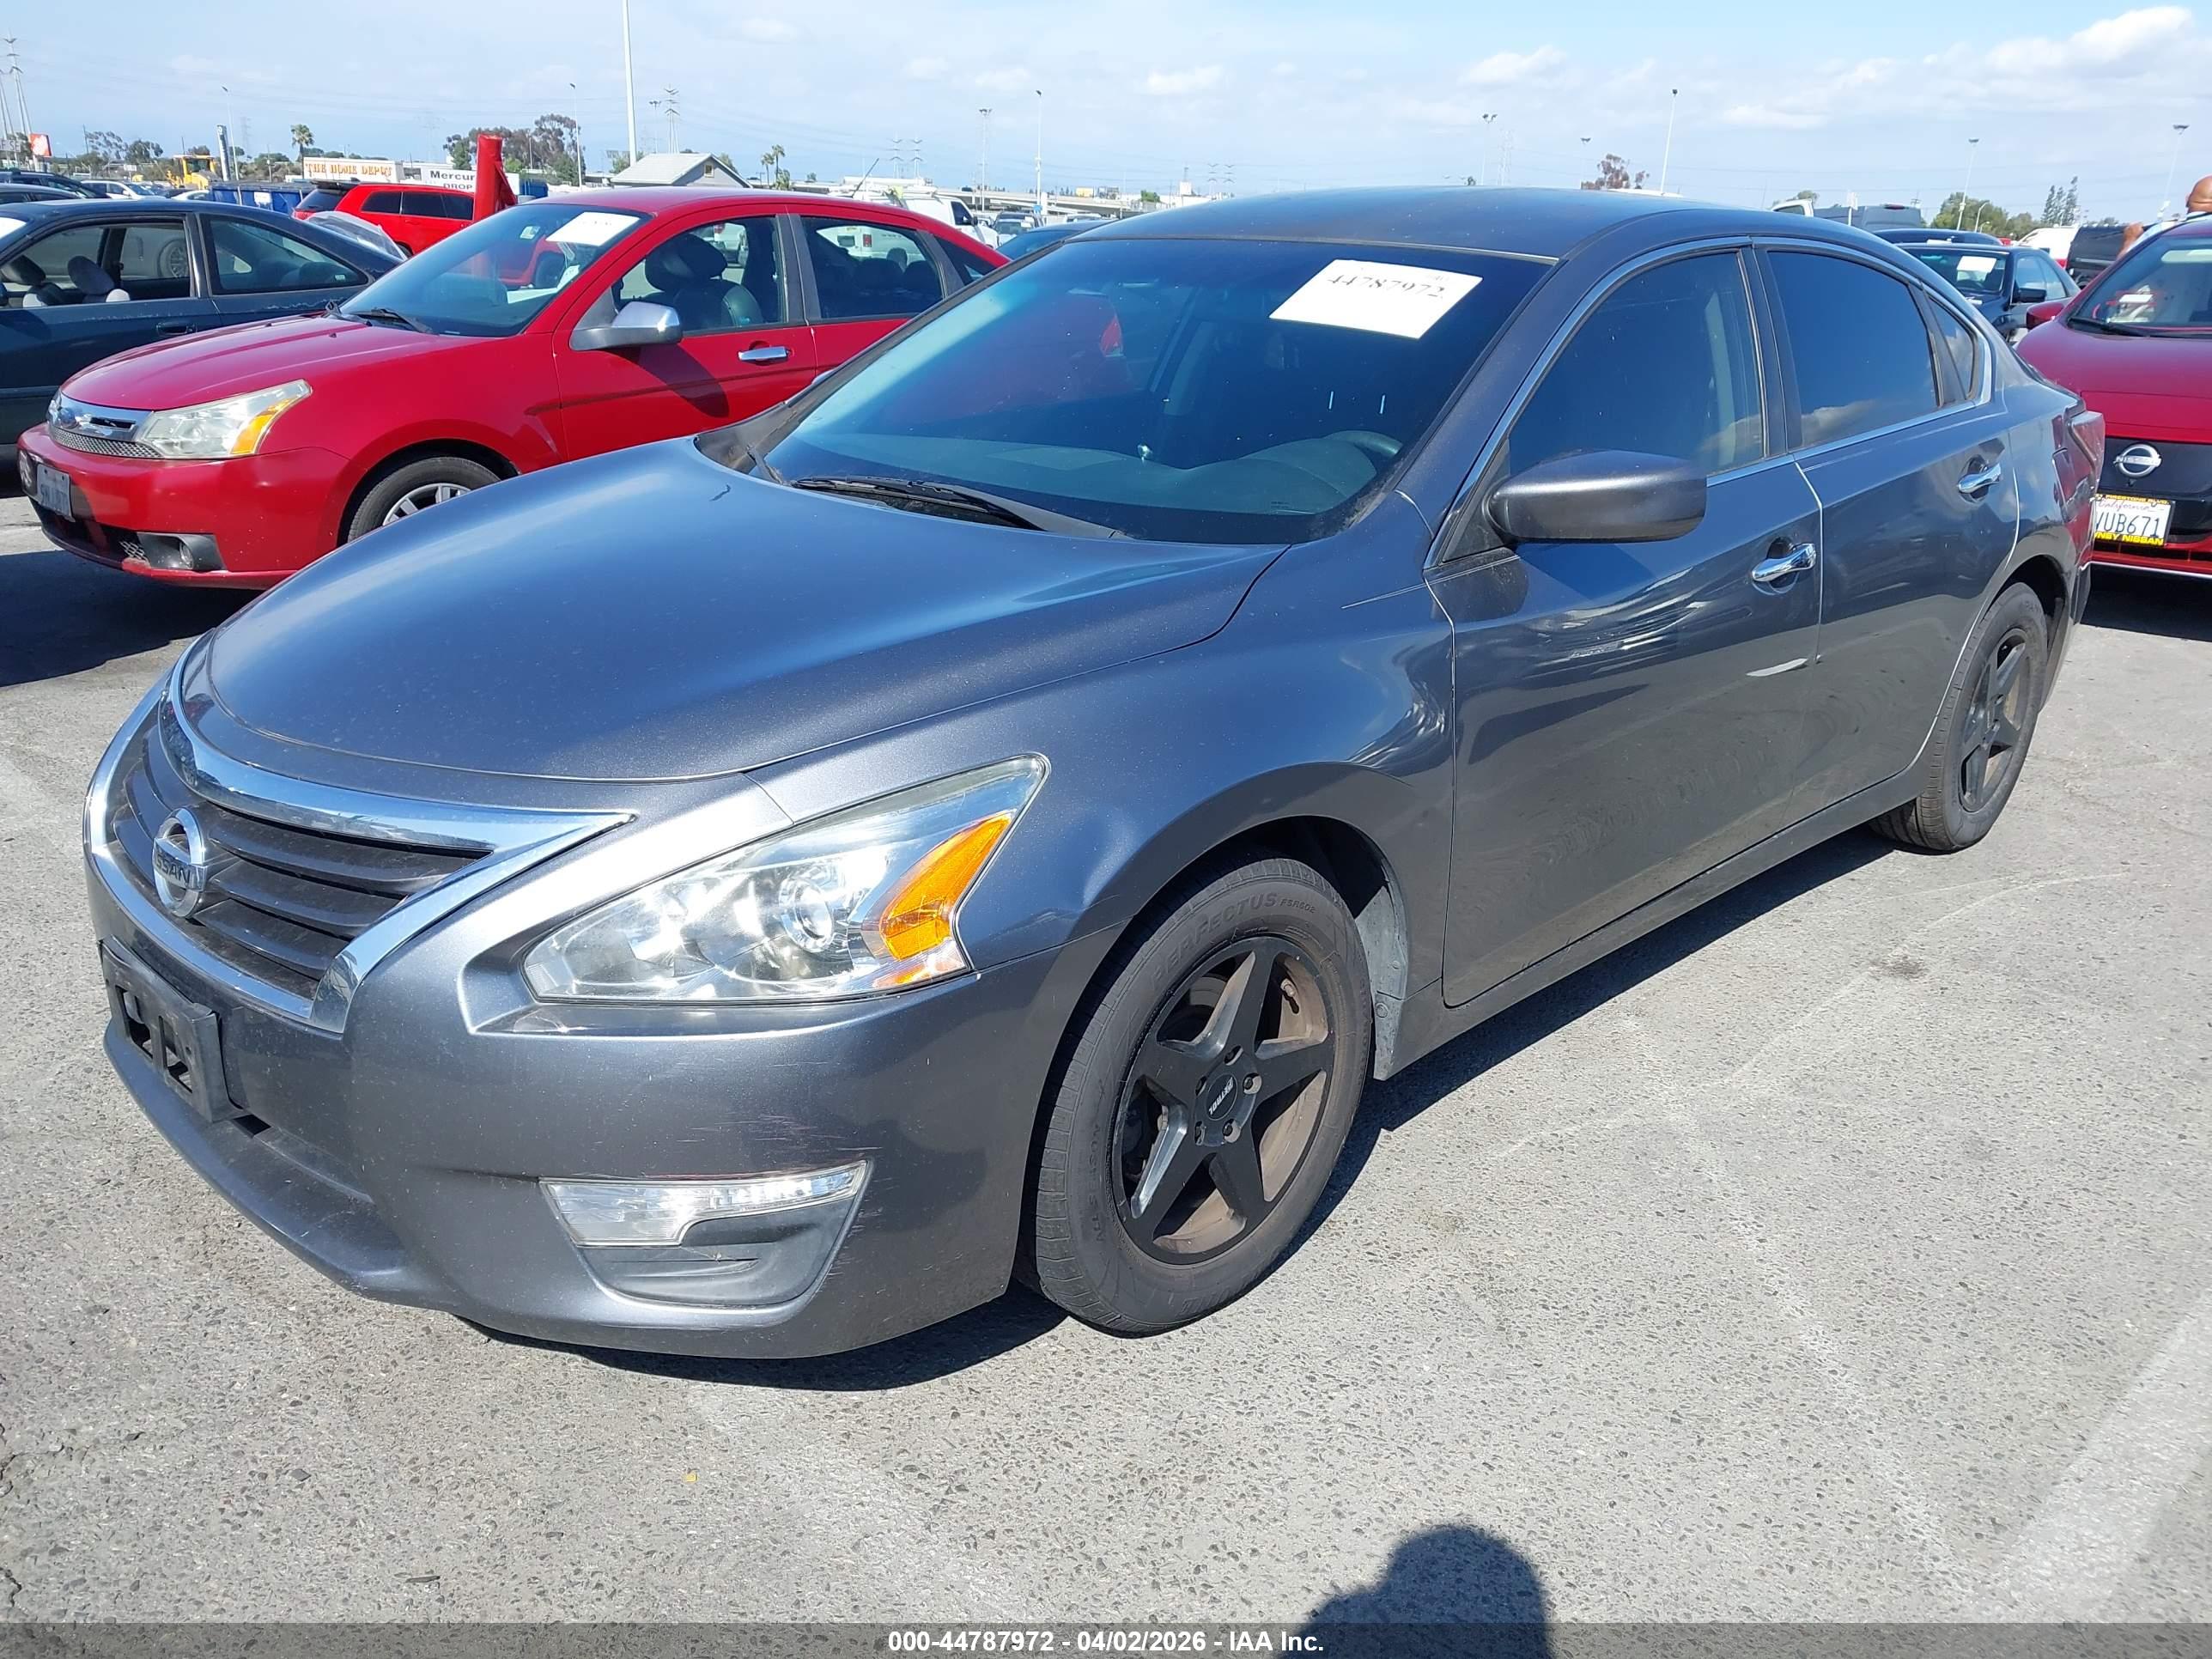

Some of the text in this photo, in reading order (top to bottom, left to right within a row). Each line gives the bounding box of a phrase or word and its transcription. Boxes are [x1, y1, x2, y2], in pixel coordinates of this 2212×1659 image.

[305, 163, 326, 173] THE
[430, 170, 475, 181] Mercur
[1327, 275, 1445, 298] 44787972
[2122, 534, 2165, 546] NISSAN
[155, 853, 191, 884] SSAN
[1279, 898, 1316, 914] FSR602
